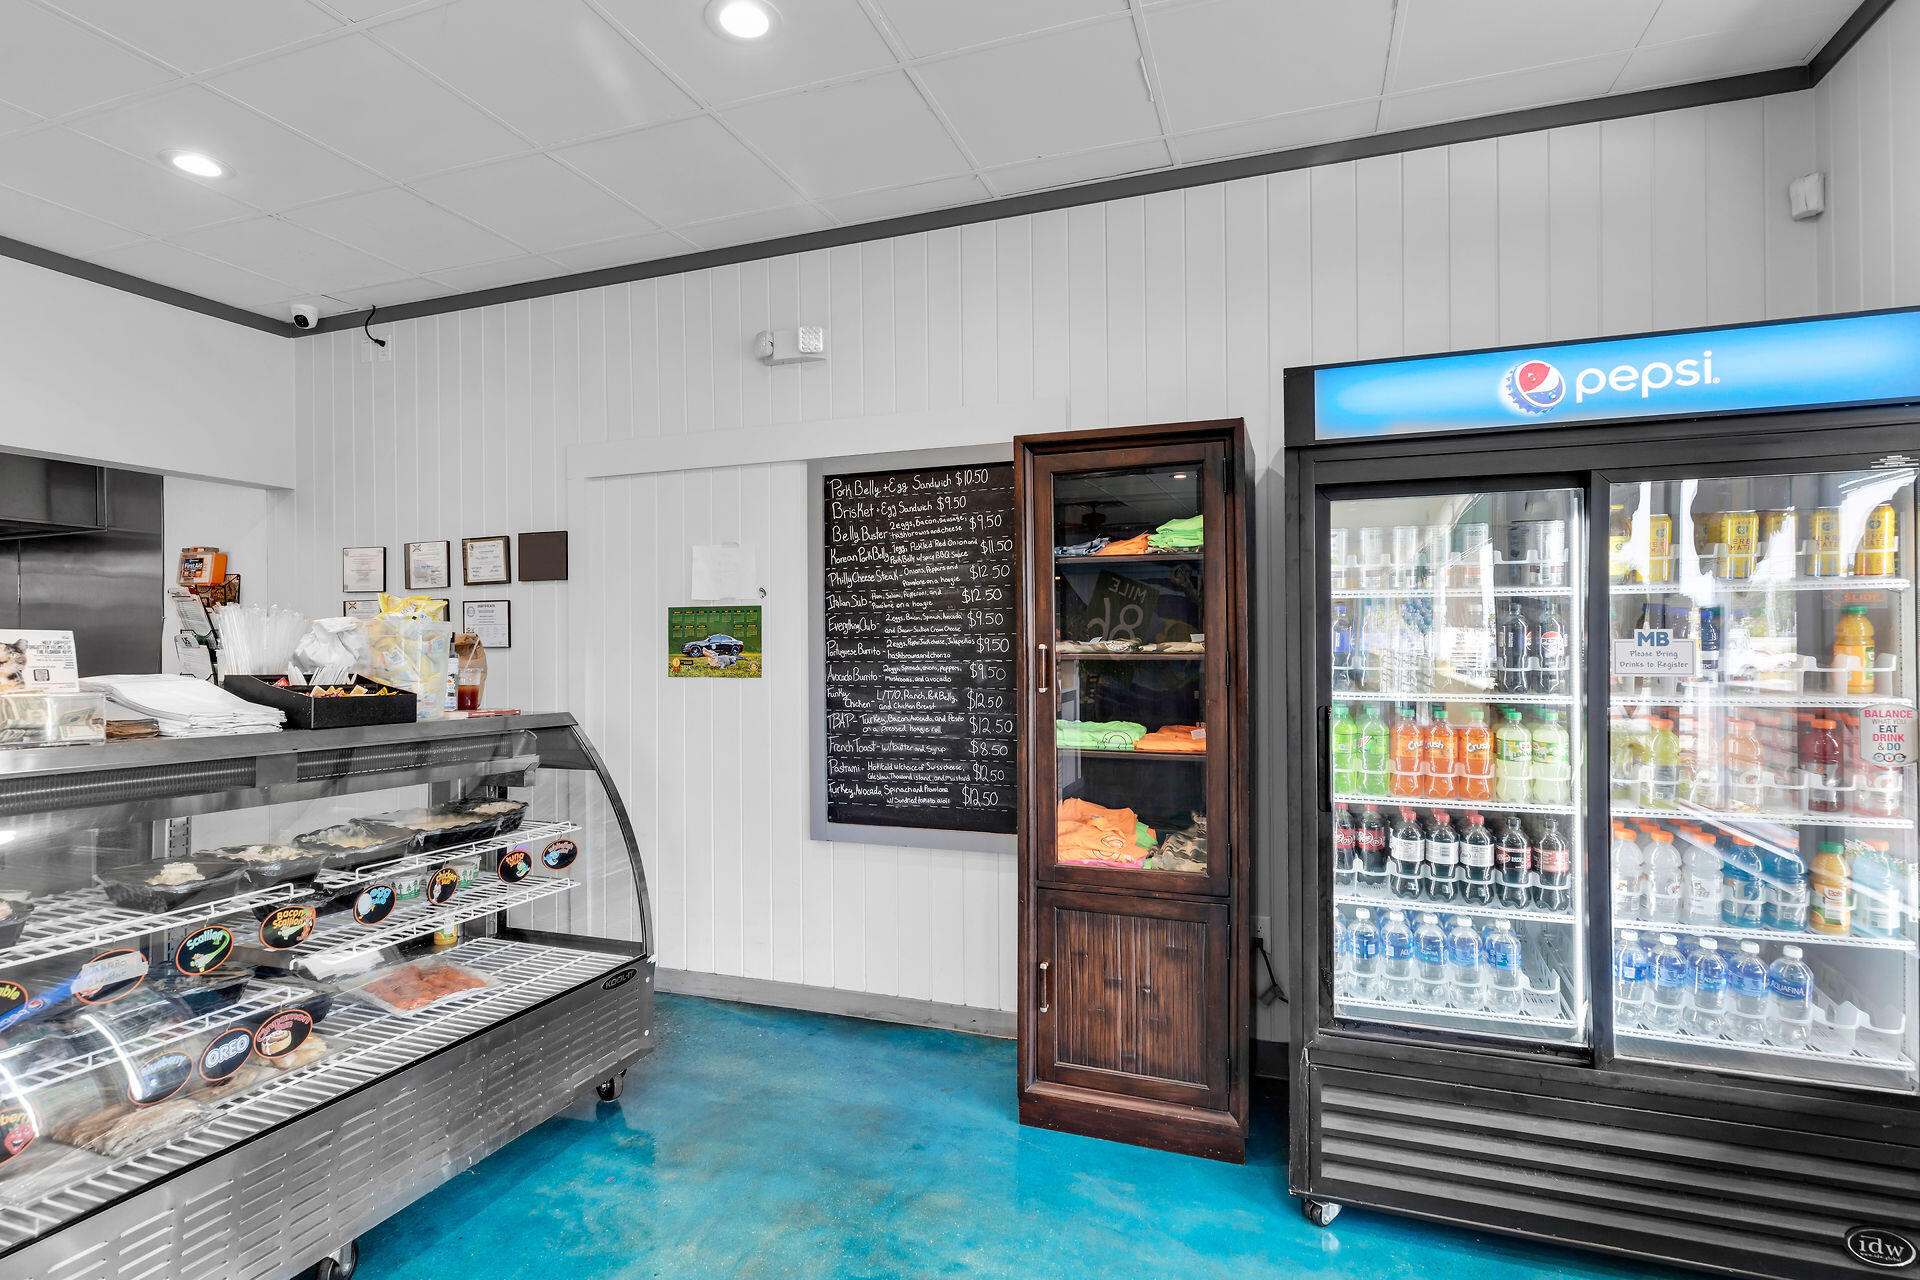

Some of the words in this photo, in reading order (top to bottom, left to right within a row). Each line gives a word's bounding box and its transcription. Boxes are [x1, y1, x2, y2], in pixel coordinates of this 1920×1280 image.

[1576, 350, 1712, 403] pepsi
[830, 479, 852, 498] Pork
[855, 480, 881, 498] Belly
[912, 475, 951, 490] Sandwich
[955, 469, 988, 486] $10.50
[881, 502, 897, 518] Egg
[899, 501, 932, 513] Sandwich
[937, 496, 966, 512] $9.50
[969, 515, 1002, 531] $9.50
[832, 526, 859, 543] Belly
[862, 526, 887, 539] Buster
[831, 549, 858, 564] Korean
[858, 548, 873, 562] Pork
[873, 545, 889, 562] Belly
[980, 540, 1013, 554] $11.50
[828, 573, 852, 588] Philly
[852, 571, 874, 582] Cheese
[970, 565, 1010, 580] $12.50
[940, 577, 960, 585] hoagie
[828, 595, 850, 609] Italian
[962, 588, 1002, 603] $12.50
[912, 601, 933, 609] hoagie
[829, 616, 860, 634] Everything
[968, 611, 1003, 628] $9.50
[976, 636, 1009, 653] $9.50
[1638, 632, 1670, 646] MB
[858, 643, 880, 656] Burrito
[1656, 651, 1678, 659] Bring
[970, 662, 1006, 680] $9.50
[1658, 662, 1688, 670] Register
[827, 667, 852, 682] Avocado
[852, 667, 878, 682] Burrito
[967, 688, 1002, 711] $12.50
[1864, 710, 1912, 718] BALANCE
[909, 725, 929, 733] hoagie
[969, 715, 1012, 735] $12.50
[1873, 734, 1904, 742] DRINK
[829, 736, 853, 753] French
[968, 738, 1008, 758] $8.50
[1467, 742, 1490, 752] Crush
[828, 759, 860, 774] Pastrami
[973, 762, 1005, 782] $12.50
[884, 786, 912, 795] Spinach
[962, 784, 998, 806] $12.50
[277, 910, 304, 920] Bacon
[272, 918, 303, 929] Scallion
[186, 929, 224, 950] Scallion
[1770, 981, 1806, 996] AQUAFINA
[205, 1034, 250, 1069] OREO
[1859, 1235, 1904, 1257] idw
